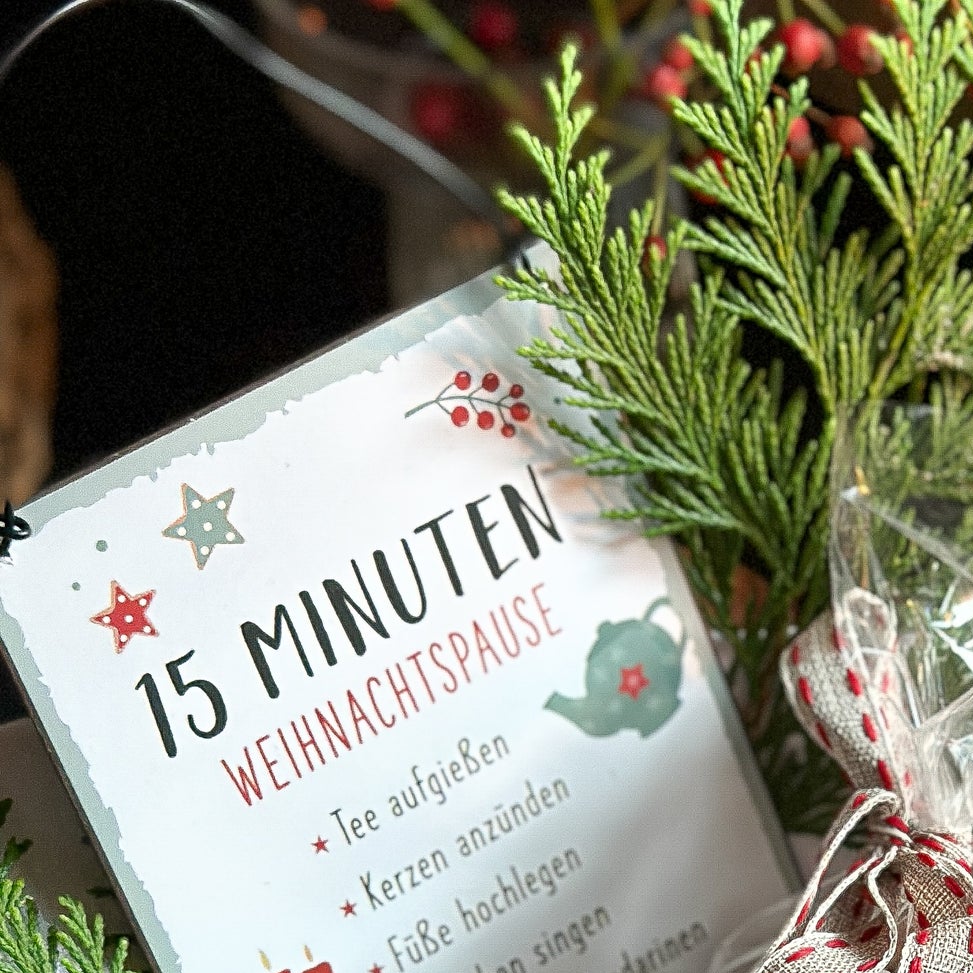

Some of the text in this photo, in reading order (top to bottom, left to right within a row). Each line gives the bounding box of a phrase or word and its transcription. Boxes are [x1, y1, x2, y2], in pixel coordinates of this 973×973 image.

[135, 465, 563, 758] 15 MINUTEN
[220, 583, 563, 806] WEIHNACHTSPAUSE
[330, 735, 510, 845] Tee aufgießen
[360, 777, 570, 911] Kerzen anzünden
[387, 848, 583, 972] Füße hochlegen
[533, 905, 612, 967] singen
